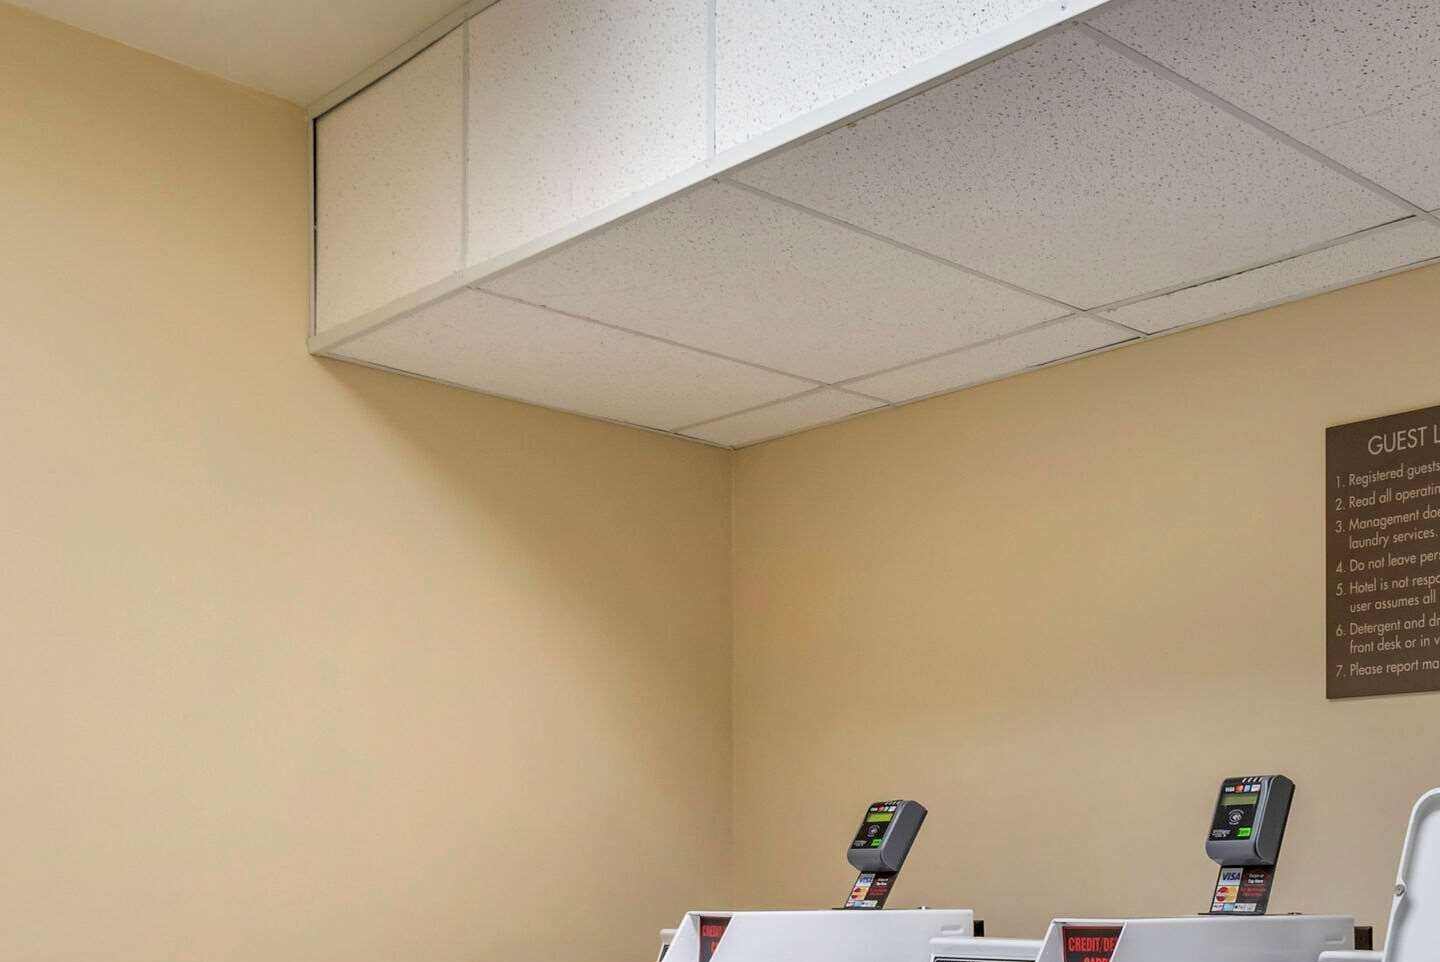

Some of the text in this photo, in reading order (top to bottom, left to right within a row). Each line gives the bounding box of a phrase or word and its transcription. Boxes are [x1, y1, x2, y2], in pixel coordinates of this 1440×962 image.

[1367, 425, 1428, 456] GUEST
[1336, 475, 1345, 489] 1.
[1348, 463, 1404, 488] Registered
[1406, 460, 1440, 480] guests
[1335, 497, 1346, 511] 2.
[1348, 490, 1376, 509] Read
[1378, 487, 1392, 504] all
[1335, 520, 1346, 534] 3.
[1348, 509, 1420, 531] Management
[1349, 527, 1439, 550] laundry services.
[1335, 582, 1346, 597] 5.
[1349, 577, 1377, 595] Hotel
[1380, 577, 1389, 591] is
[1391, 576, 1409, 589] not
[1349, 602, 1372, 613] user
[1374, 596, 1420, 610] assumes
[1422, 589, 1436, 605] all
[1335, 664, 1346, 678] 7.
[1349, 662, 1384, 676] Please
[1386, 659, 1419, 676] report
[1222, 871, 1241, 881] VISA
